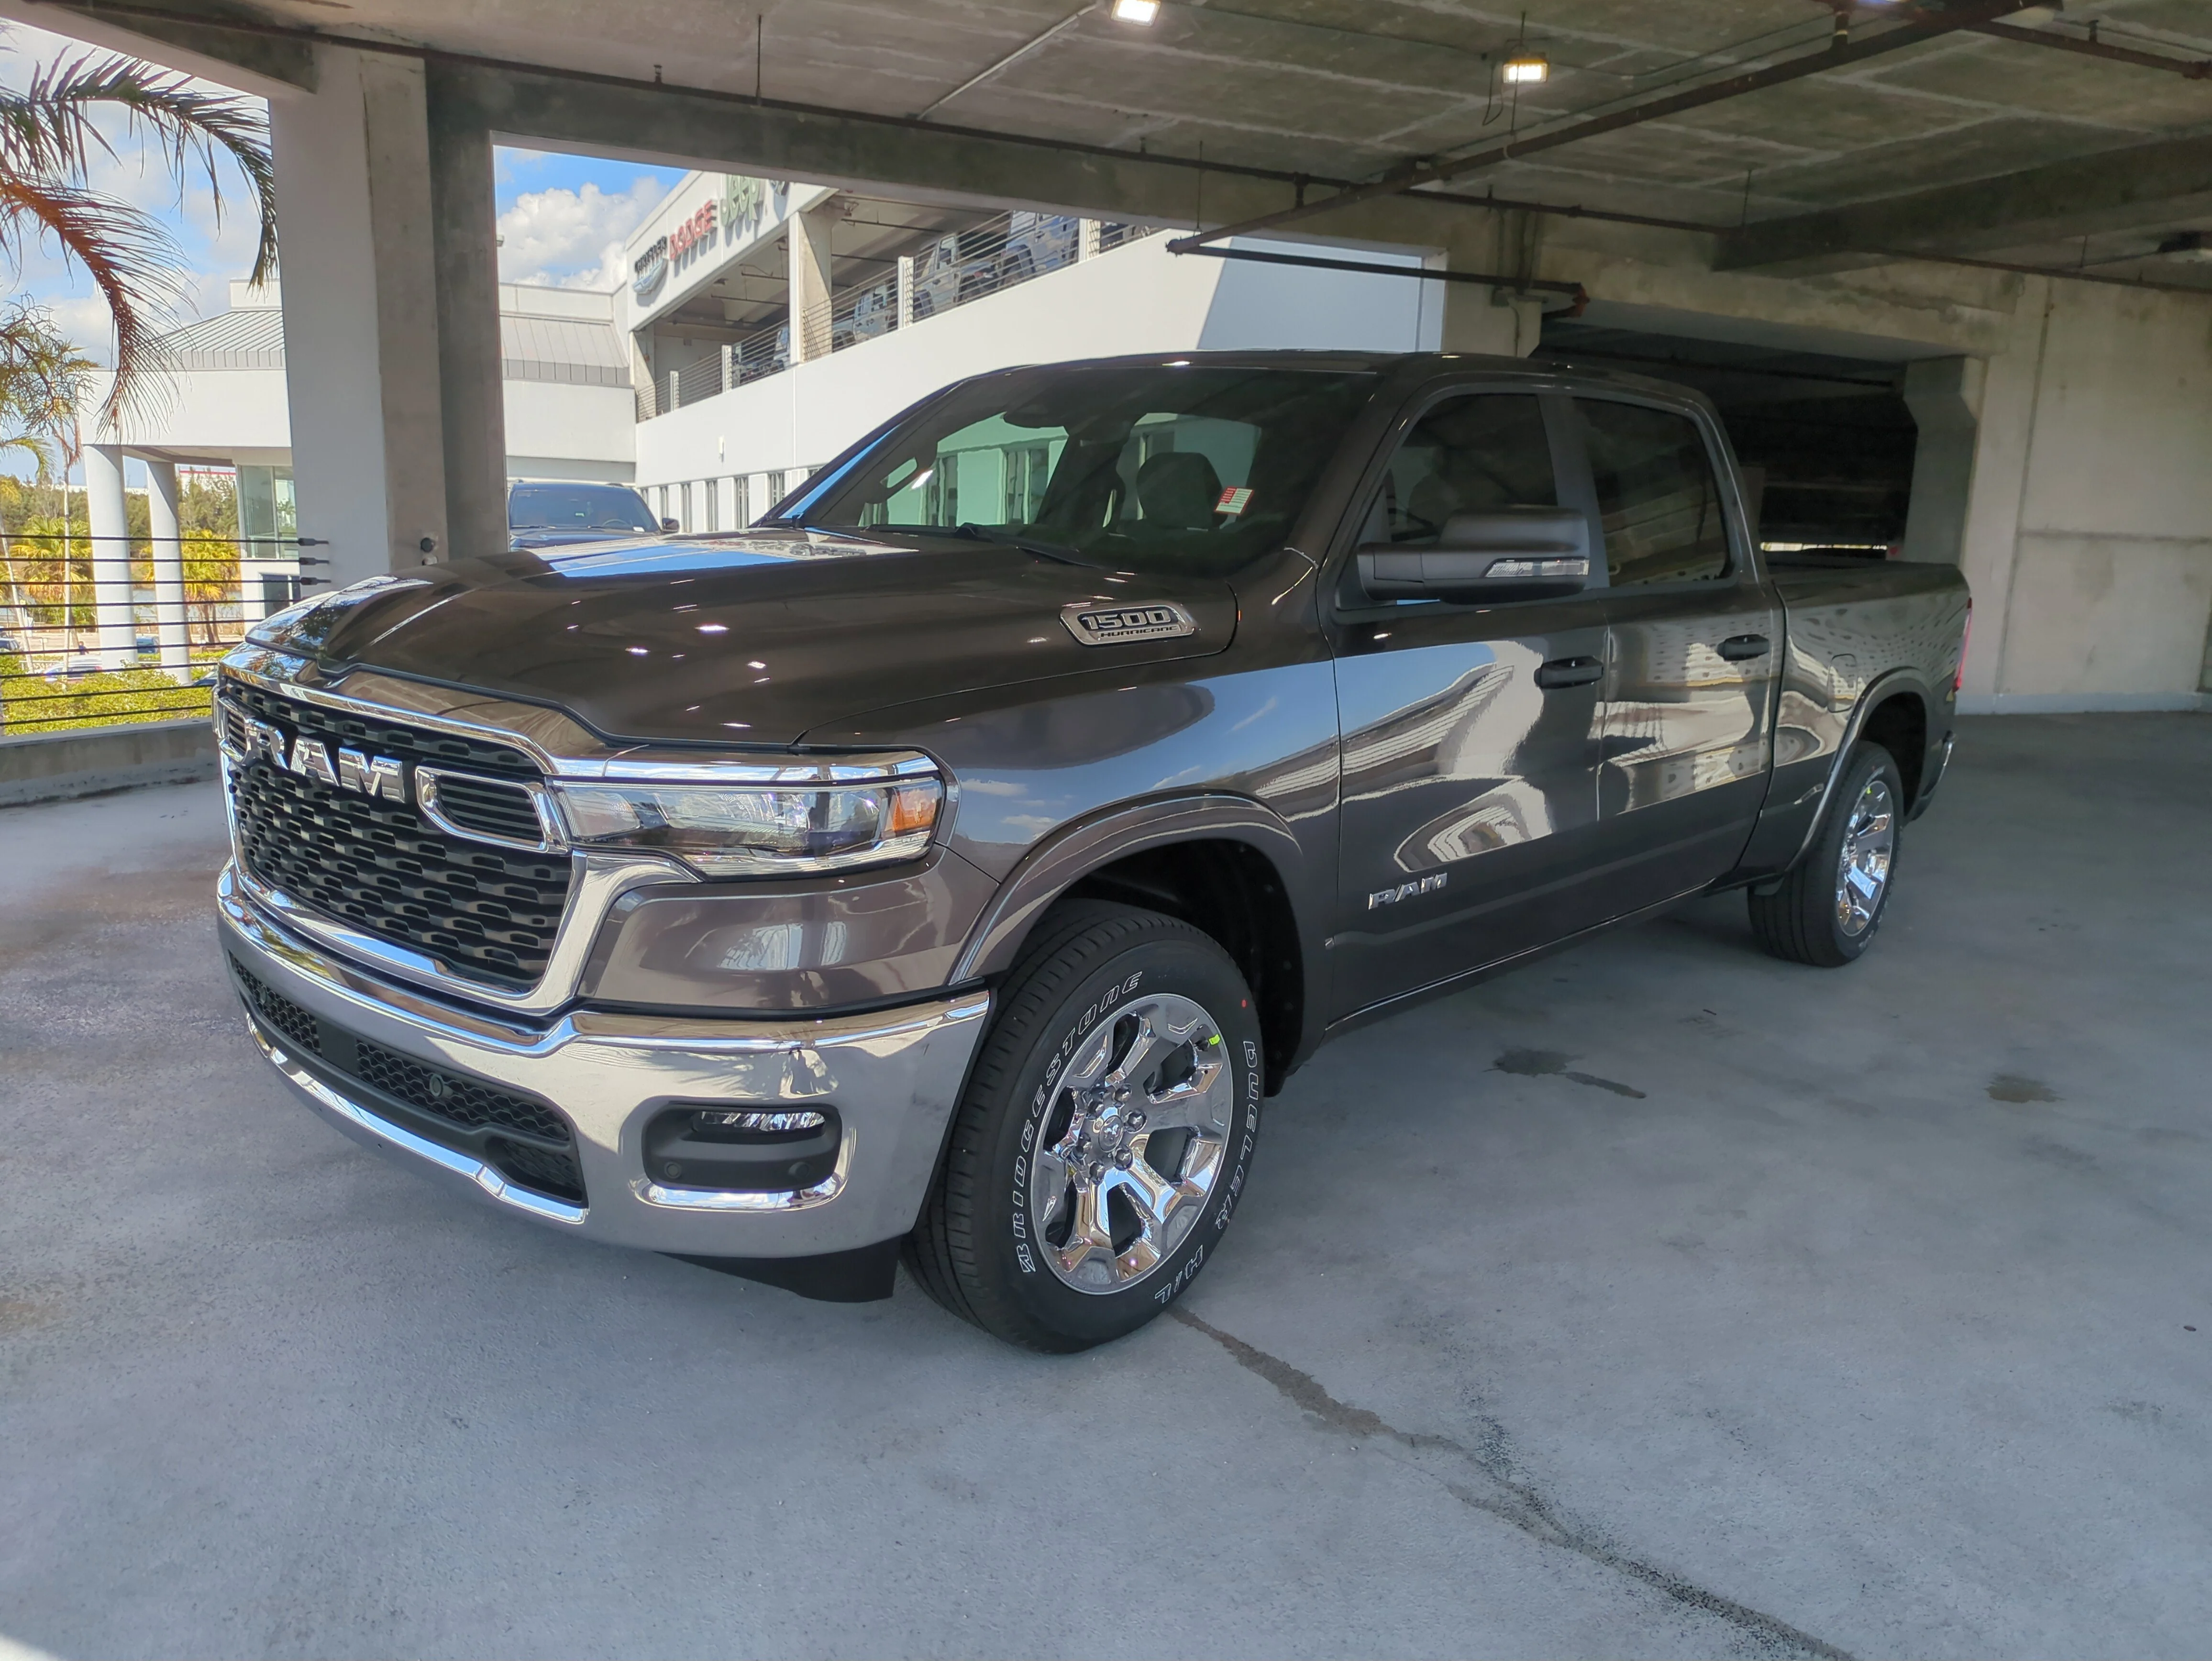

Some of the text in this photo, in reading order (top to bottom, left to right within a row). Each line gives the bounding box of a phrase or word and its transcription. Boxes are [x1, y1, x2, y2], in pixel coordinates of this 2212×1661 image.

[670, 199, 717, 261] DODGE
[1081, 609, 1172, 630] 1500
[1100, 626, 1178, 637] HURRICANE
[243, 718, 406, 804] RAM
[1368, 873, 1448, 910] RAM
[1013, 971, 1142, 1273] BRIDGESTONE
[1215, 1041, 1259, 1229] DUELER
